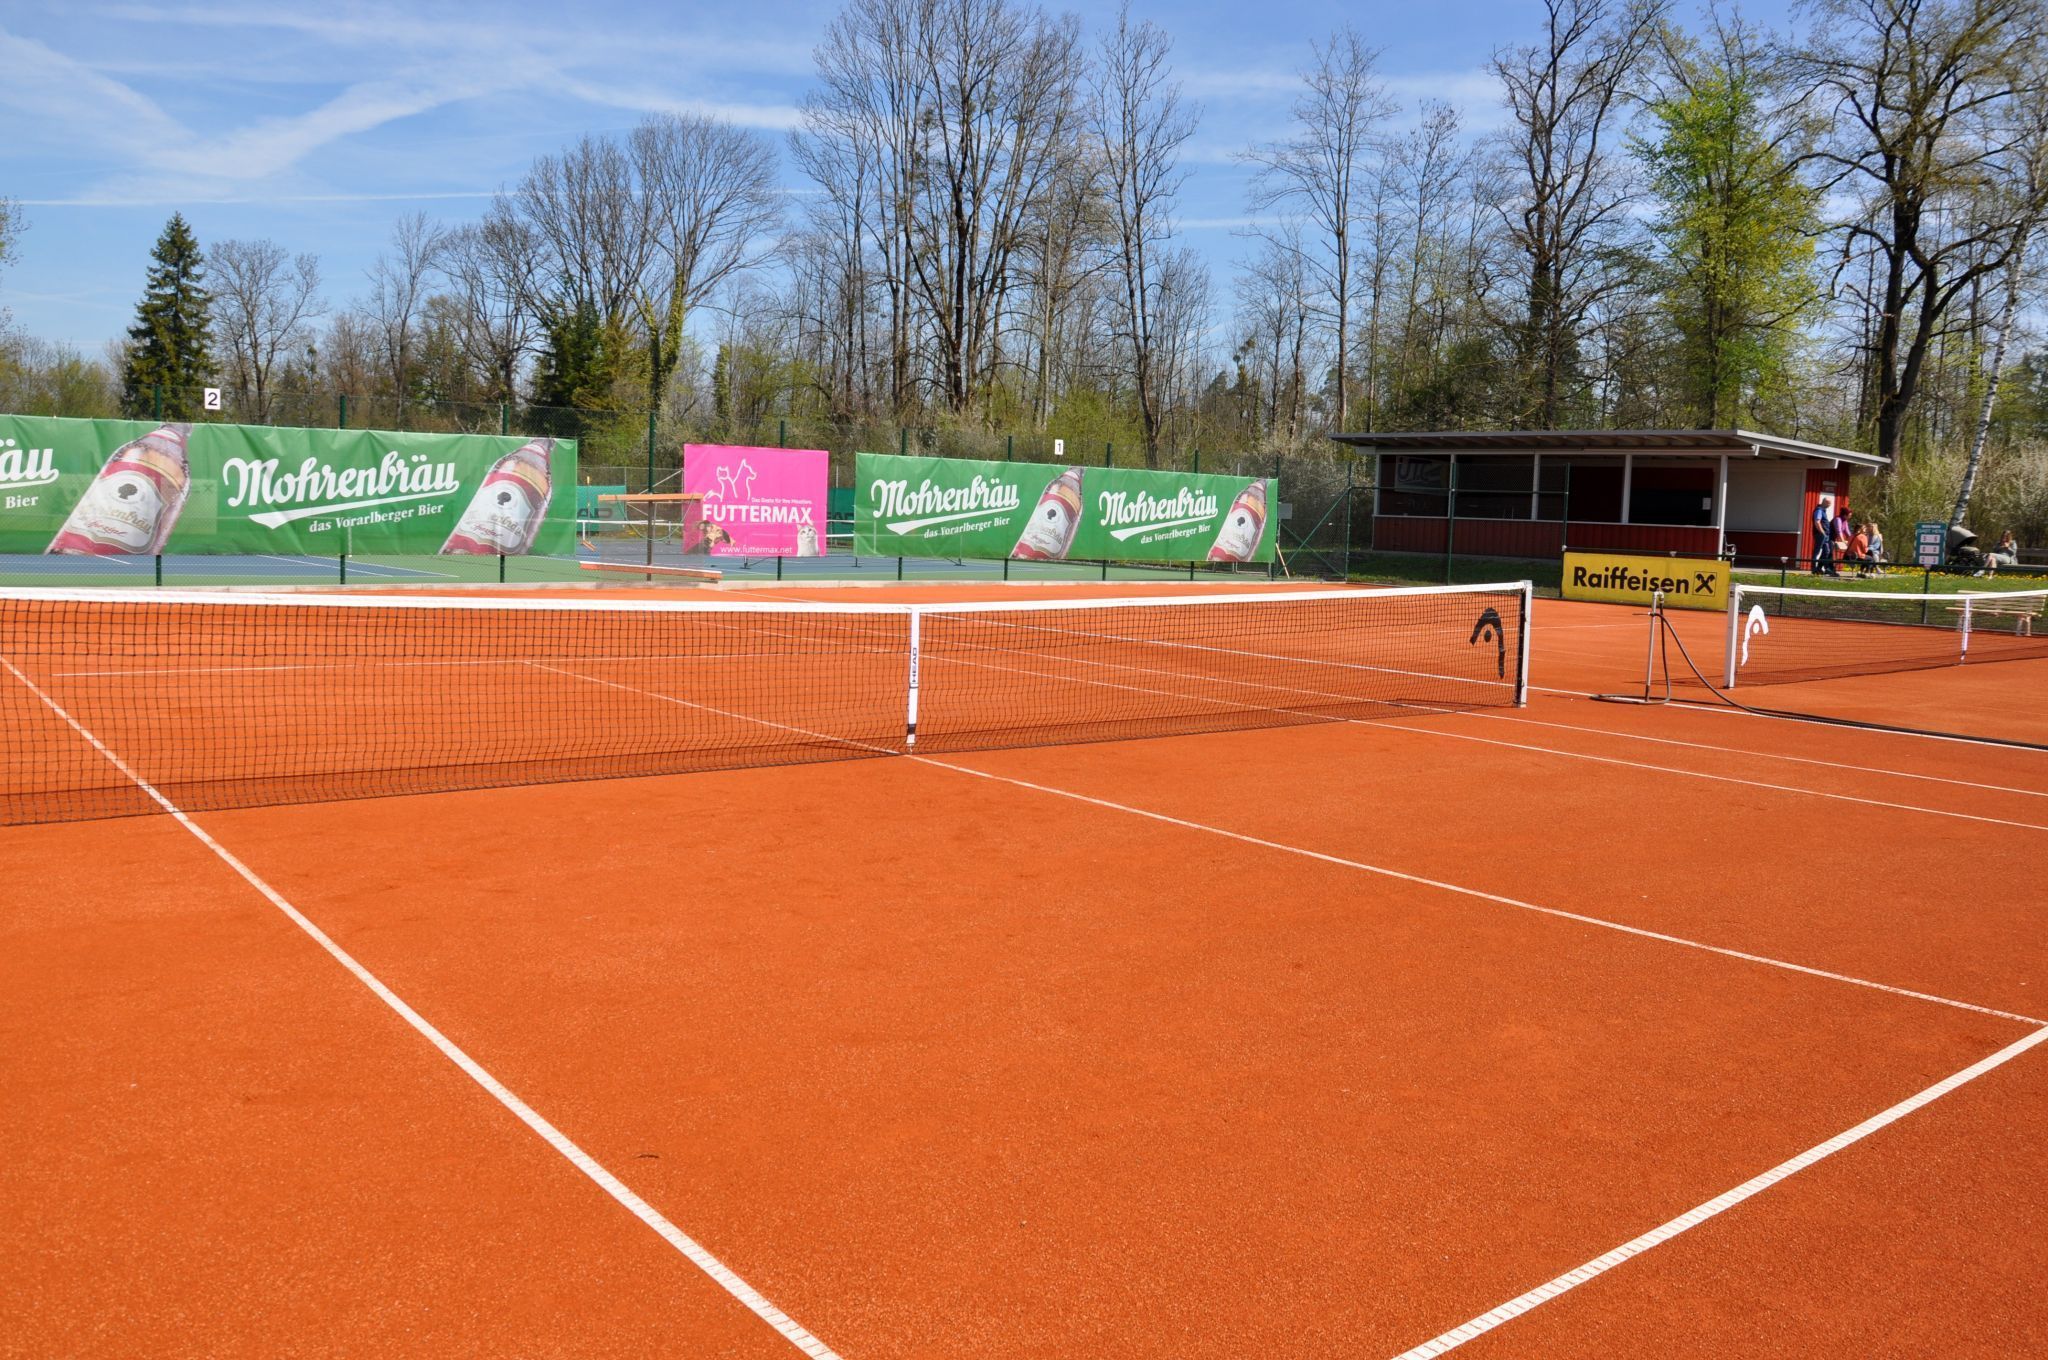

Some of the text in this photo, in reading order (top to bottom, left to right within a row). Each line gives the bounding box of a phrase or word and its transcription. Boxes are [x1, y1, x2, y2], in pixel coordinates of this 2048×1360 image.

[208, 392, 218, 406] 2
[222, 450, 460, 507] Mohrenbräu
[6, 495, 38, 509] Bier
[870, 474, 1020, 518] Mohrenbräu
[1099, 486, 1219, 526] Mohrenbräu
[309, 503, 444, 533] das Vorarlberger Bier
[702, 504, 813, 524] FUTTERMAX
[924, 517, 1010, 539] das Vorarlberger Bier
[1141, 523, 1211, 544] das Vorarlberger Bier
[720, 544, 792, 554] www.futtermax.net
[1573, 566, 1689, 594] Raiffeisen
